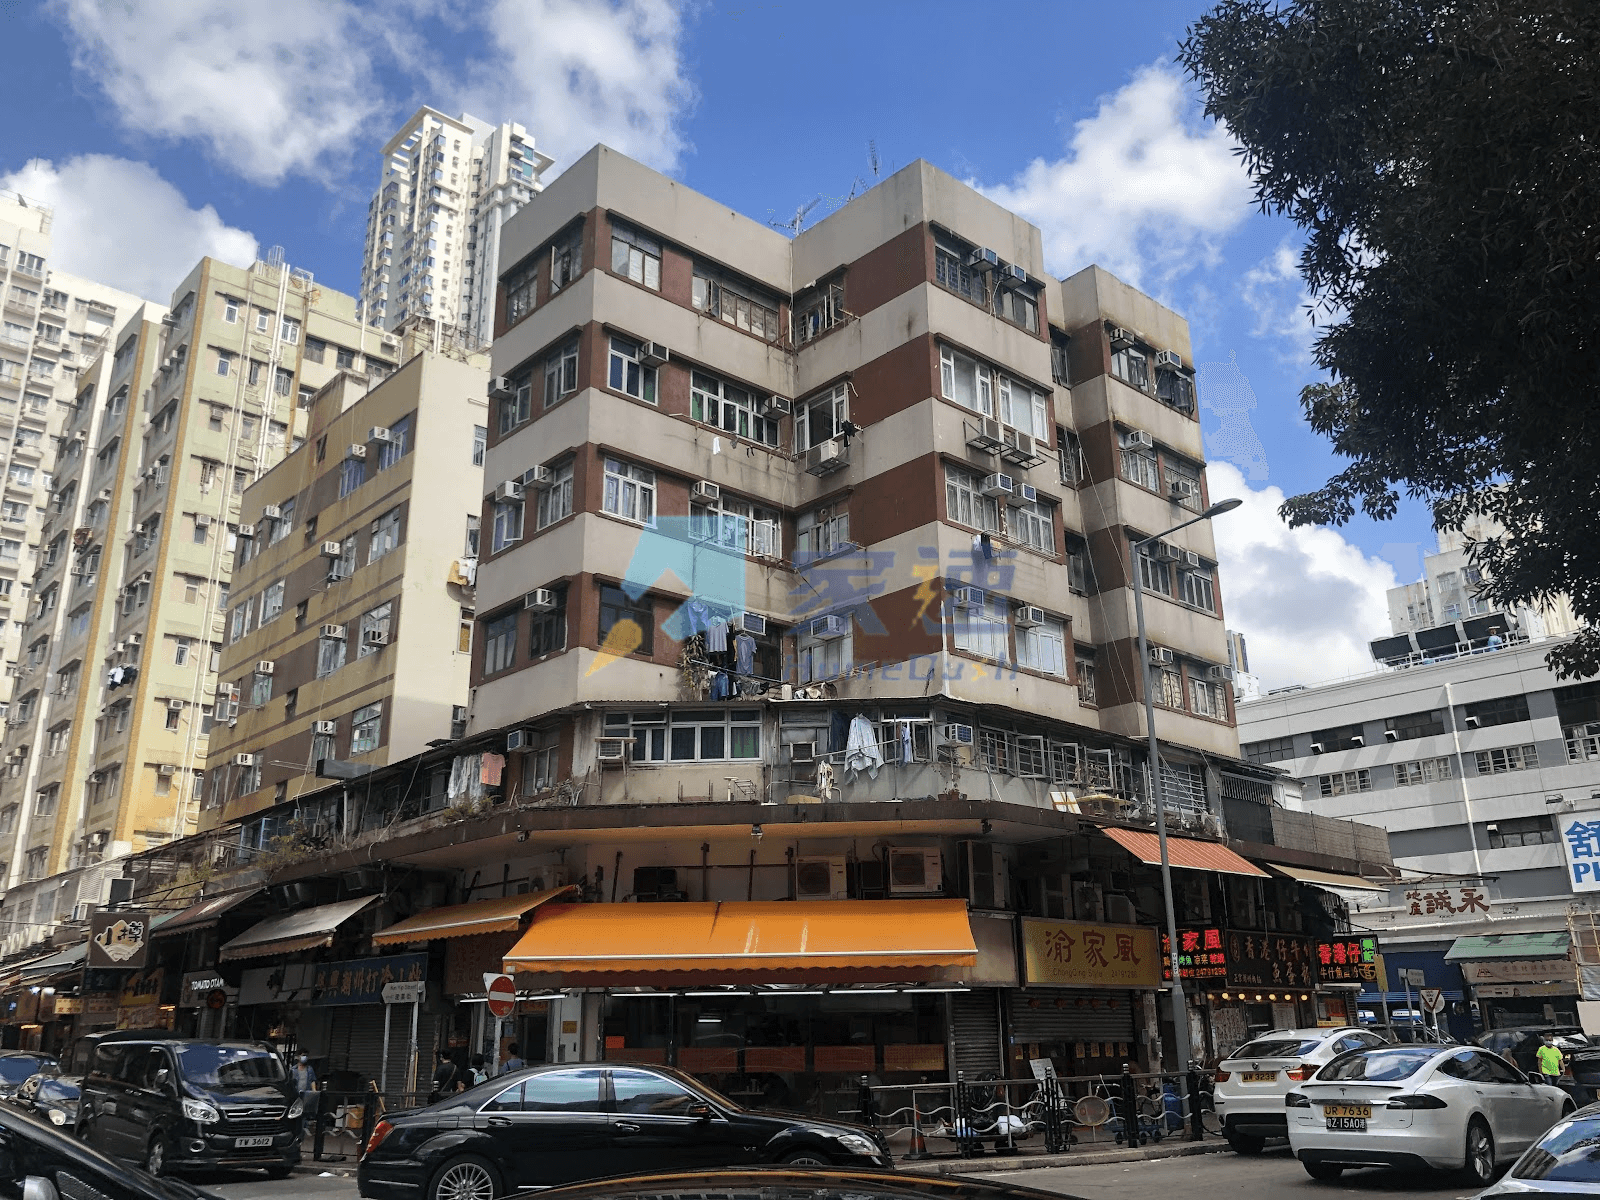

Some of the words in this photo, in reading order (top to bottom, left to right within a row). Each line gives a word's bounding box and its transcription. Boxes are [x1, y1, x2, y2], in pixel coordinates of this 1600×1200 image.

[1319, 942, 1360, 965] 香港仔
[1325, 1106, 1338, 1115] UR
[1342, 1106, 1369, 1116] 7636
